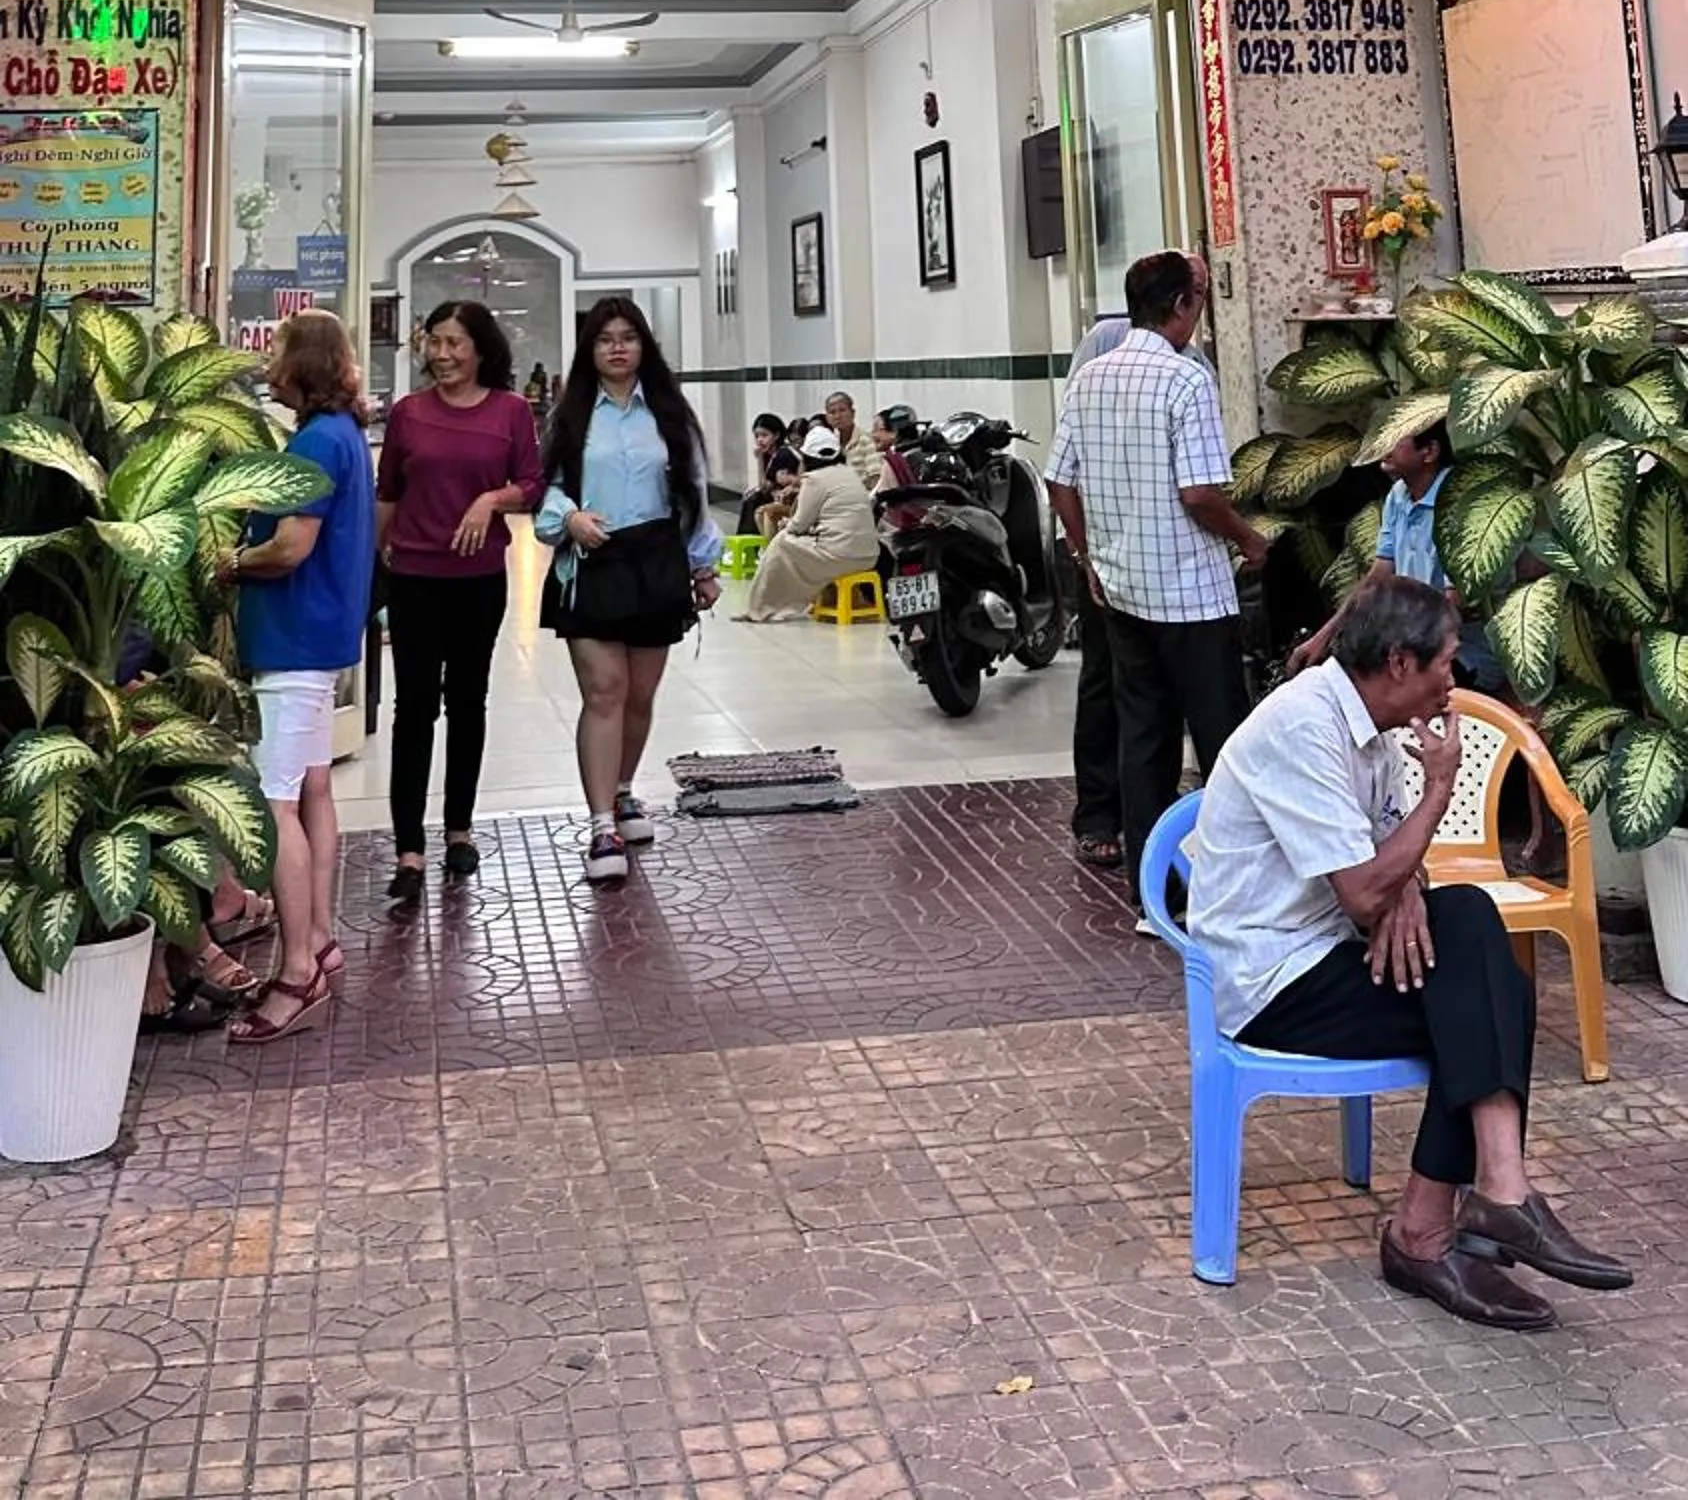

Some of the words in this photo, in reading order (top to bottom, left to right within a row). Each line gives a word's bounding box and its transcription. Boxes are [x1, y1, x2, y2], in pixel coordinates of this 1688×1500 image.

[1237, 37, 1304, 75] 0292.
[1308, 38, 1357, 75] 3817
[1364, 38, 1410, 75] 883
